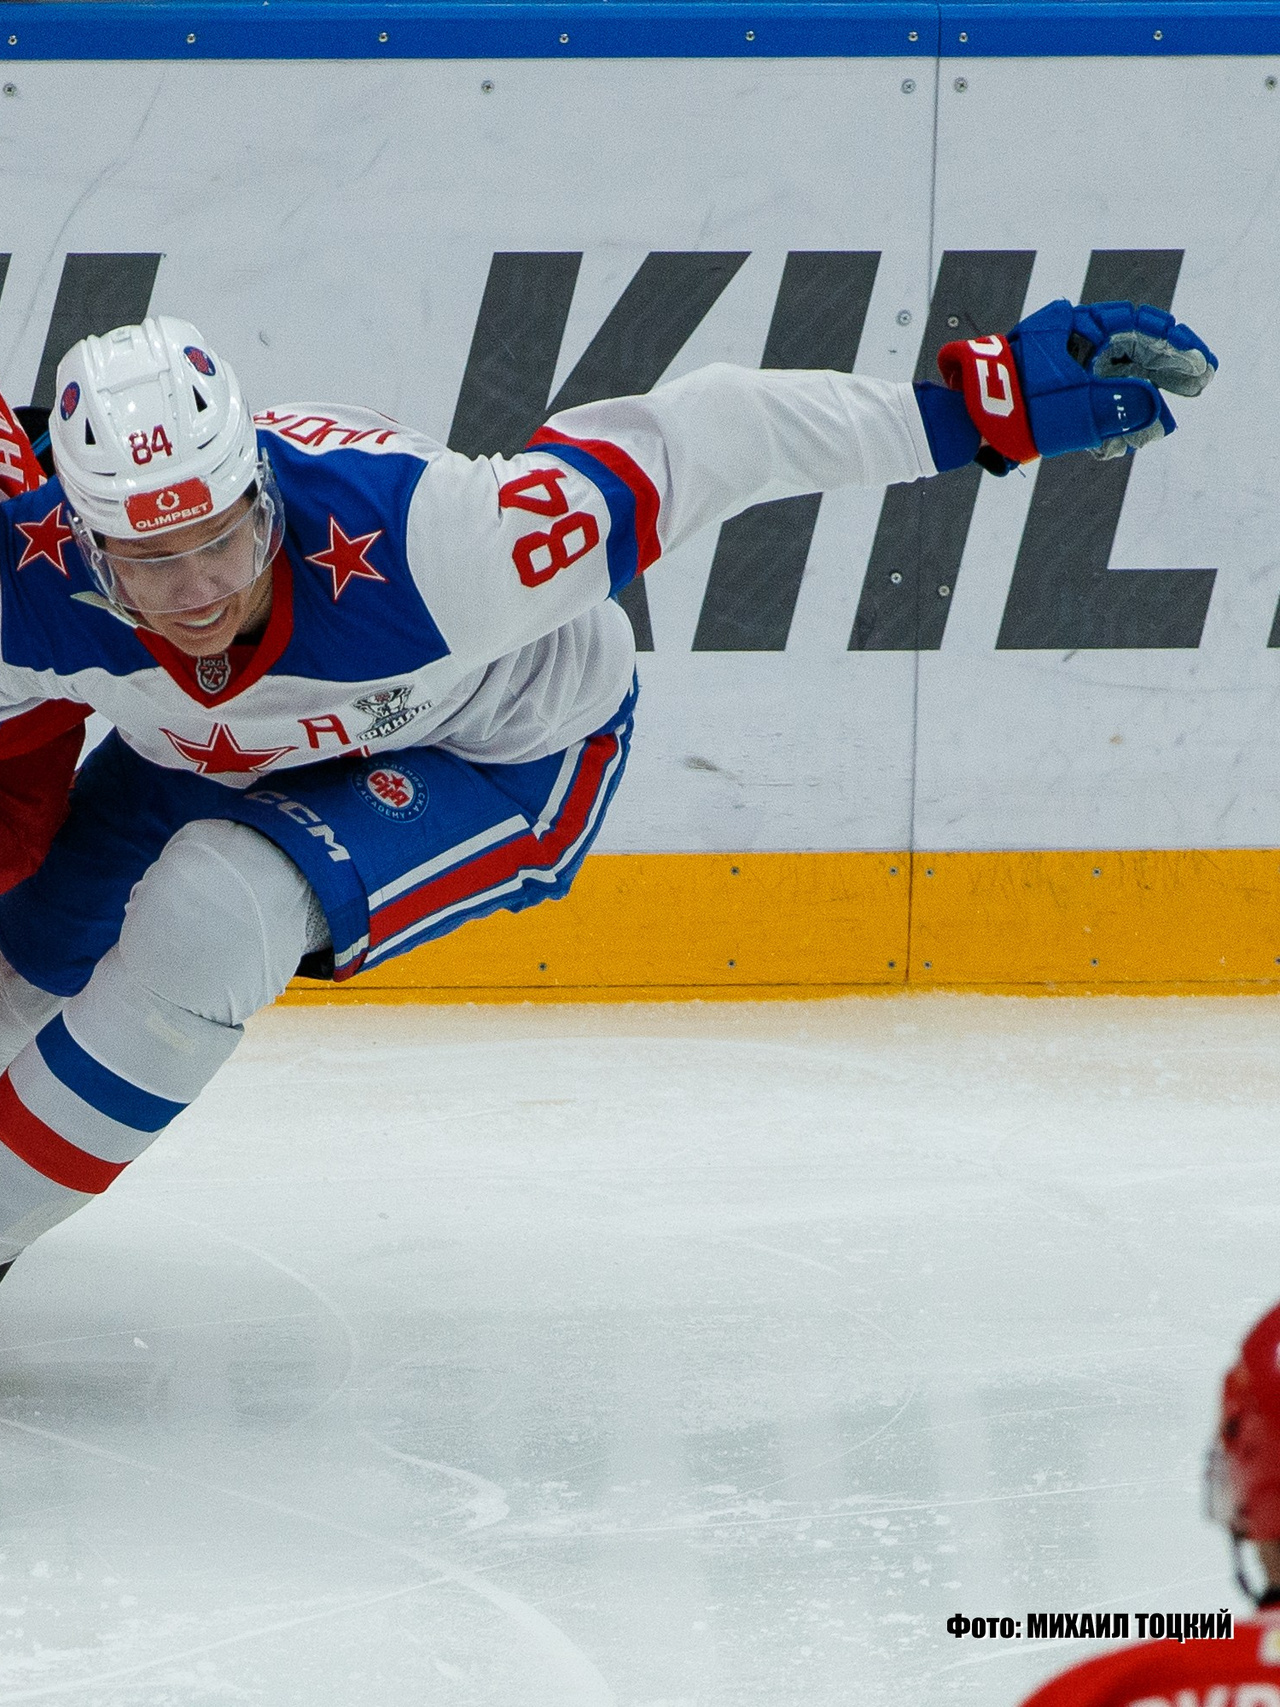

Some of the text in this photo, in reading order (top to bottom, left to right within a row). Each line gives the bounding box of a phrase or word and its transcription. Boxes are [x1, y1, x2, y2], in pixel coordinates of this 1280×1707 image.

[129, 424, 173, 465] 84
[135, 503, 209, 529] OLIMPBET
[498, 468, 600, 588] 84
[359, 701, 433, 742] ФИНАЛ
[243, 791, 351, 862] CCM
